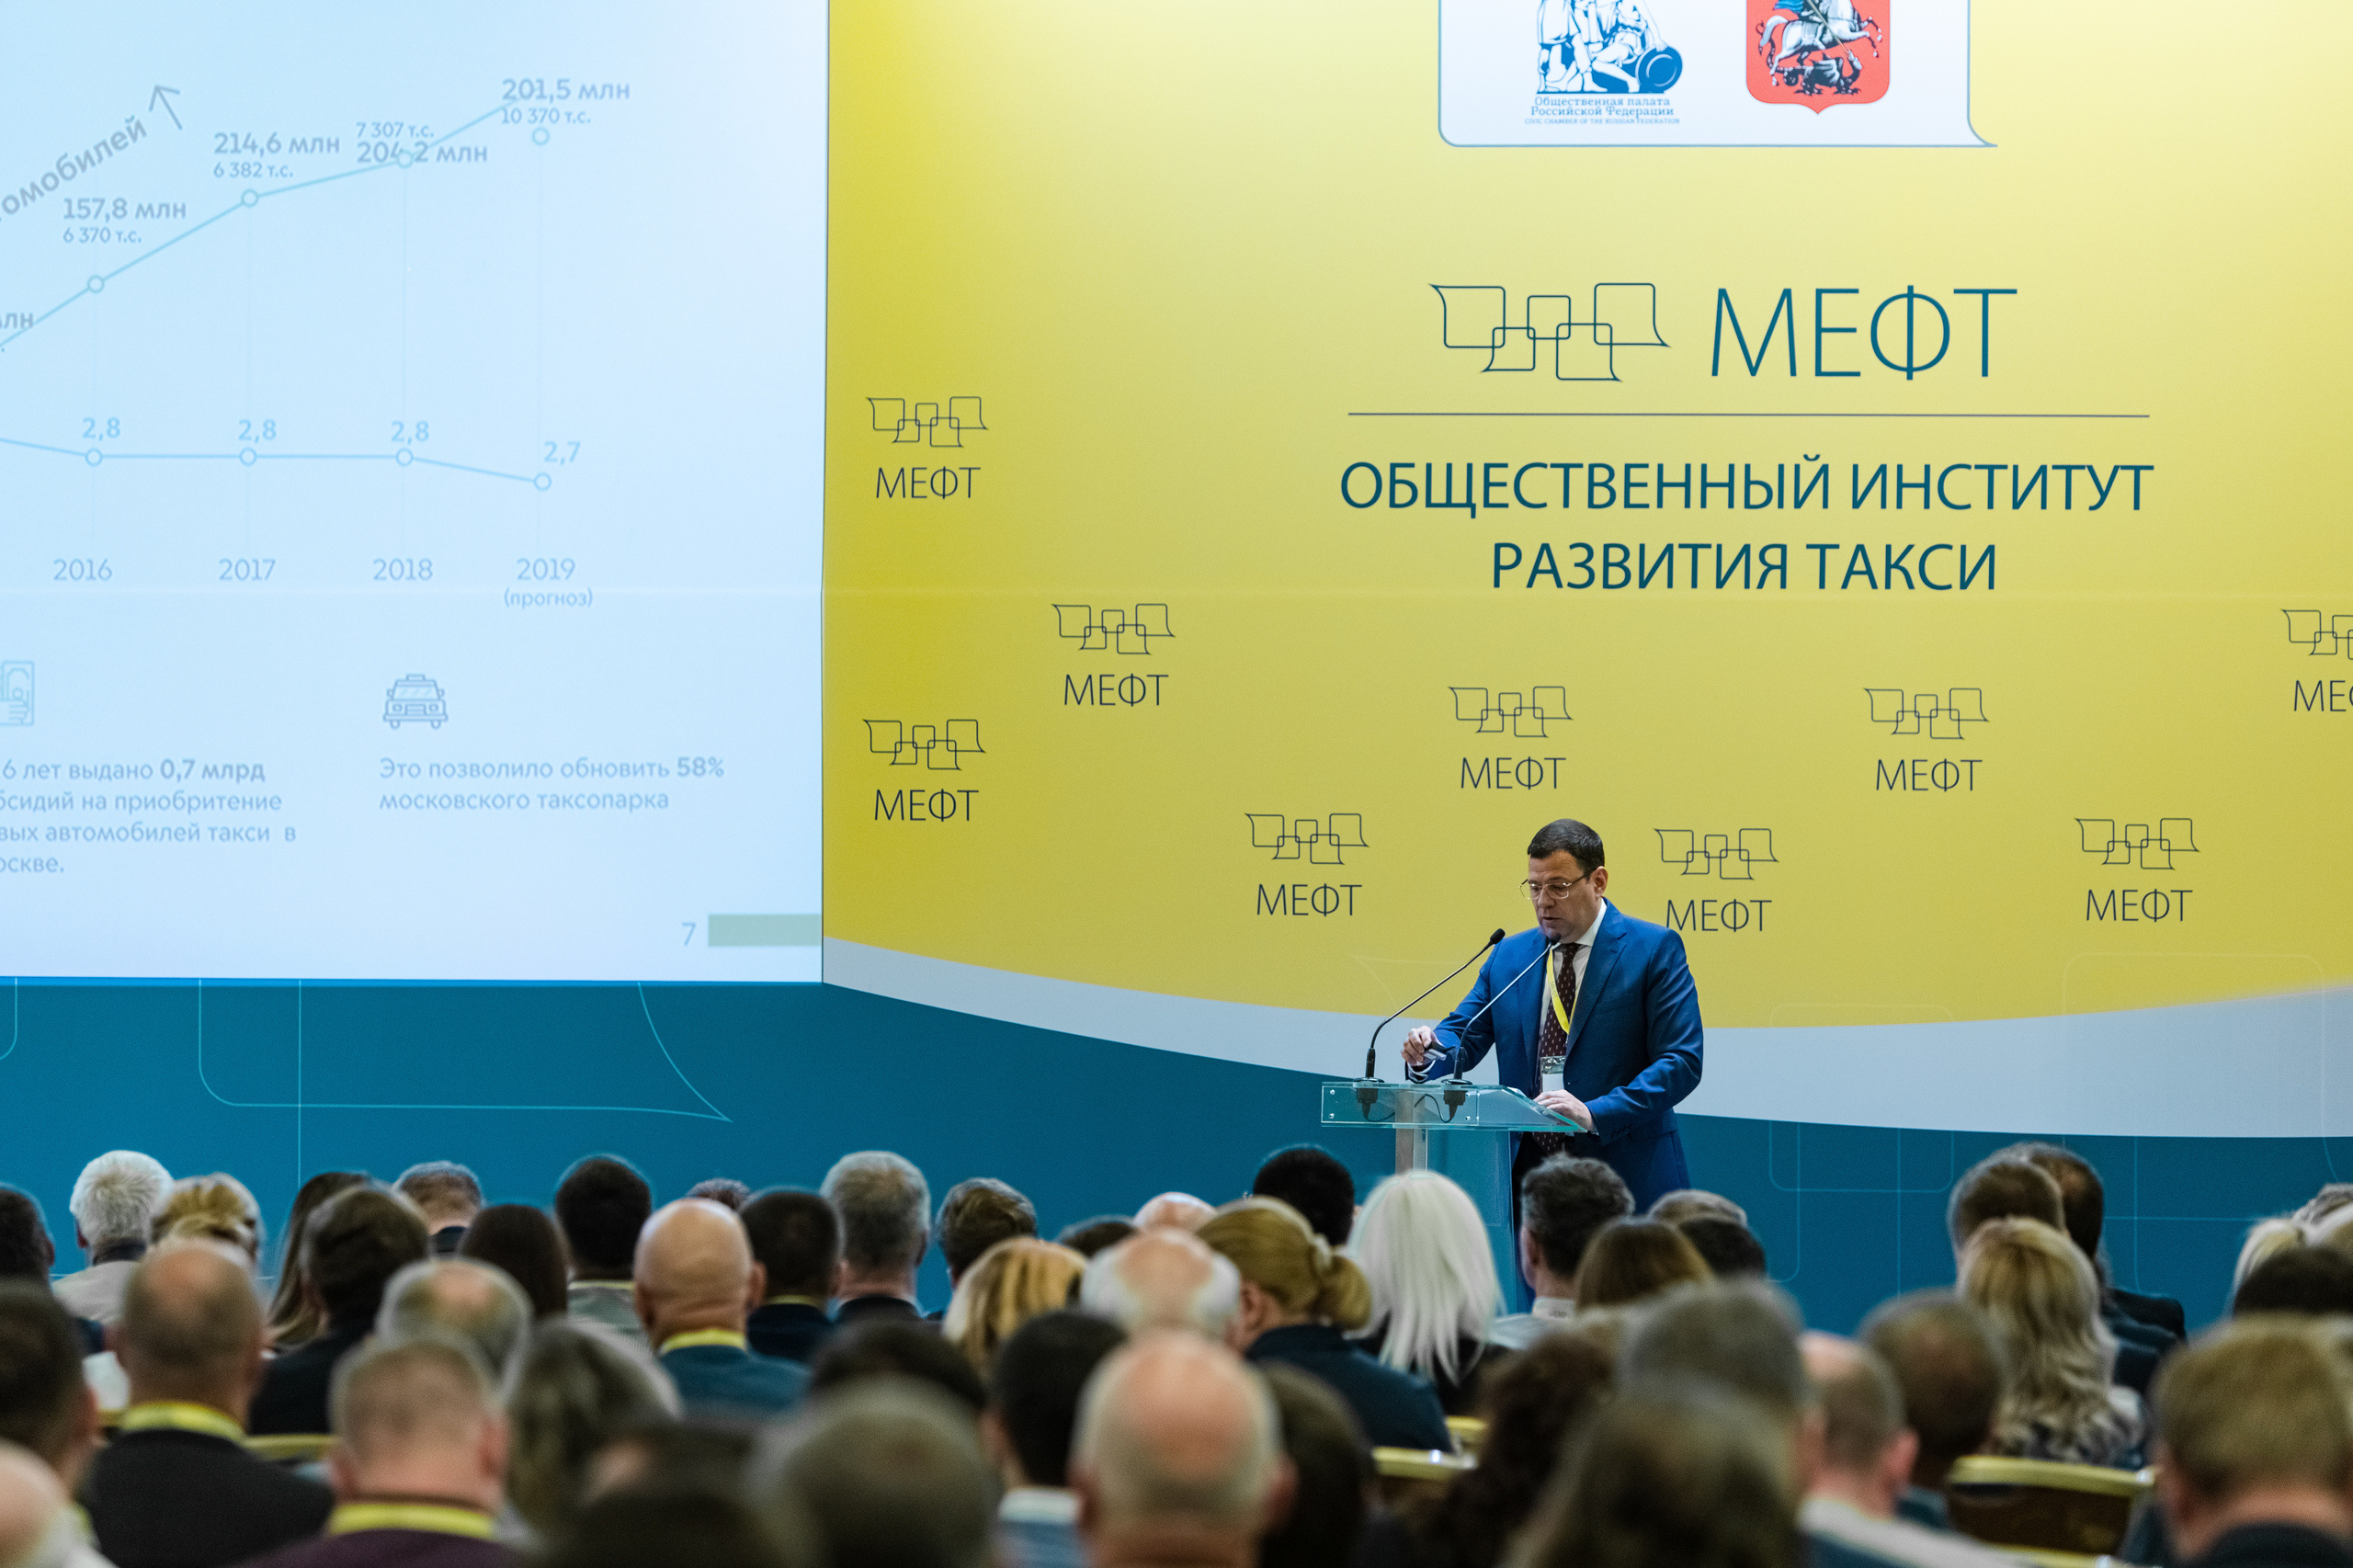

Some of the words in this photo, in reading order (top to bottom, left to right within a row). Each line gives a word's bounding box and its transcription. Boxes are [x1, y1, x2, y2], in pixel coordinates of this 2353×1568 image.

[502, 78, 571, 103] 201,5
[578, 85, 630, 100] млн
[1534, 97, 1624, 108] Общественная
[1627, 98, 1671, 107] палата
[502, 108, 522, 124] 10
[527, 108, 561, 125] 370
[565, 111, 591, 124] т.с.
[1530, 106, 1603, 116] Российской
[1605, 106, 1675, 119] Федерации
[357, 122, 367, 139] 7
[370, 121, 404, 139] 307
[409, 125, 435, 139] т.с.
[215, 132, 281, 157] 214,6
[289, 138, 340, 153] млн
[437, 146, 488, 163] млн
[0, 115, 148, 223] омобилей
[213, 162, 224, 178] 6
[229, 162, 263, 178] 382
[267, 165, 294, 178] т.с.
[63, 198, 128, 222] 157,8
[135, 203, 187, 219] млн
[63, 227, 74, 244] 6
[78, 227, 111, 244] 370
[116, 231, 142, 244] т.с.
[1711, 285, 2018, 381] МЕФТ
[82, 417, 121, 442] 2,8
[238, 419, 277, 443] 2,8
[391, 421, 430, 443] 2,8
[544, 441, 581, 466] 2,7
[876, 466, 981, 499] МЕФТ
[1341, 454, 1828, 518] ОБЩЕСТВЕННЫЙ
[1852, 464, 2154, 512] ИНСТИТУТ
[53, 558, 113, 581] 2016
[219, 558, 277, 581] 2017
[373, 558, 434, 581] 2018
[517, 558, 576, 581] 2019
[1494, 542, 1787, 589] РАЗВИТИЯ
[1806, 544, 1995, 590] ТАКСИ
[504, 588, 594, 608] (прогноз)
[1064, 674, 1168, 707] МЕФТ
[3, 759, 17, 779] 6
[23, 764, 62, 779] лет
[69, 764, 153, 781] выдано
[160, 758, 196, 782] 0,7
[201, 764, 266, 783] млрд
[380, 758, 422, 778] Это
[429, 762, 553, 778] позволило
[561, 757, 670, 778] обновить
[677, 756, 724, 778] 58%
[1461, 756, 1565, 790] МЕФТ
[1876, 758, 1982, 792] МЕФТ
[82, 795, 108, 811] на
[115, 790, 282, 814] приобритение
[380, 793, 530, 810] московского
[537, 793, 669, 813] таксопарка
[875, 789, 979, 822] МЕФТ
[46, 821, 200, 842] автомобилей
[208, 826, 270, 842] такси
[284, 826, 297, 842] в
[1257, 883, 1362, 916] МЕФТ
[2086, 889, 2193, 922] МЕФТ
[1666, 899, 1772, 932] МЕФТ
[681, 922, 697, 947] 7
